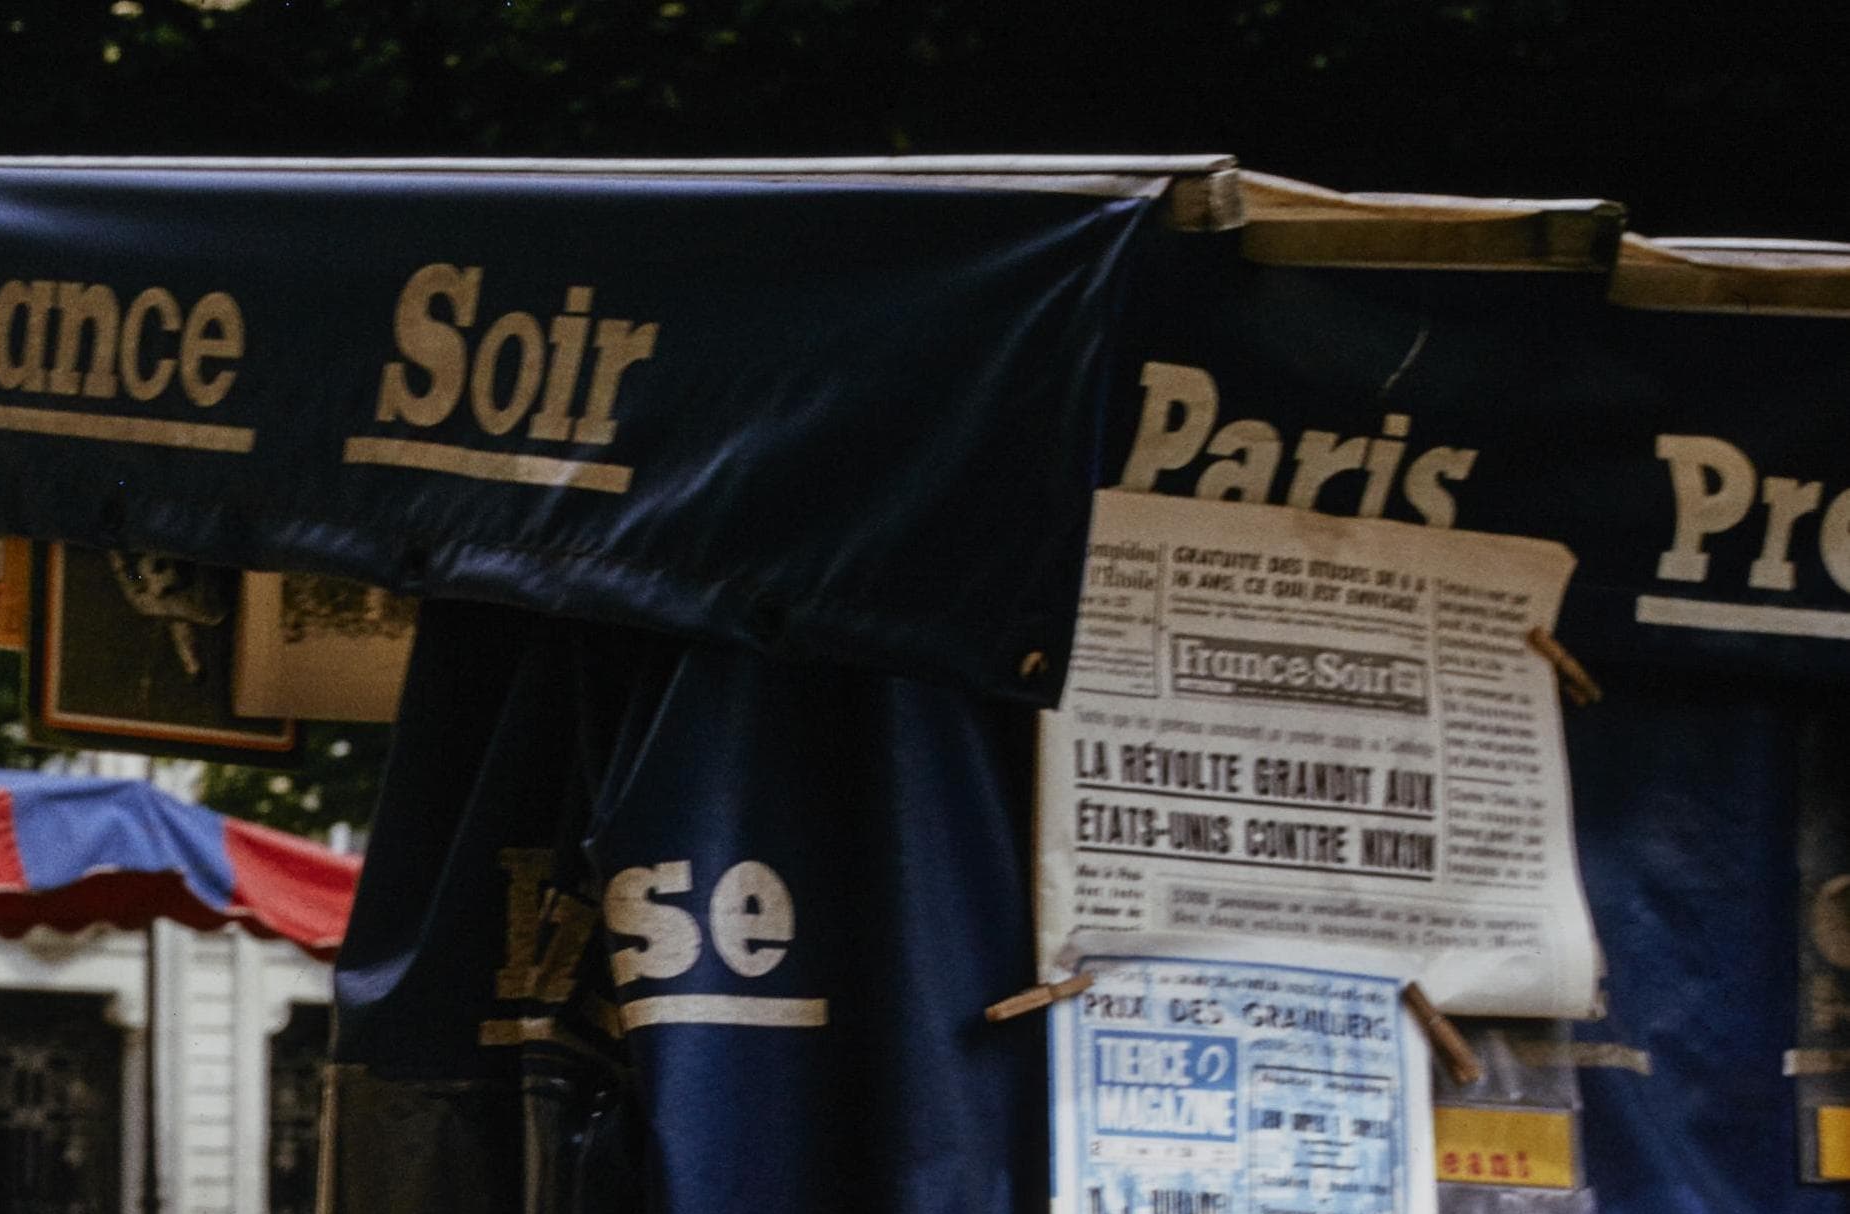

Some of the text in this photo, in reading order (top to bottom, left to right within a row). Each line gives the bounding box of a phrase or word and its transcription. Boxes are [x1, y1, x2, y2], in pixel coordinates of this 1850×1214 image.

[377, 261, 661, 446] Soir
[1120, 360, 1480, 531] Paris
[1075, 738, 1435, 811] LA RÉVOLTE GRANDIT AUX
[1076, 798, 1437, 873] ÉTATS-UNIS CONTRE NIXON
[1083, 992, 1146, 1020] PRIX
[1168, 997, 1224, 1026] DES
[1096, 1084, 1236, 1138] MAGAZINE
